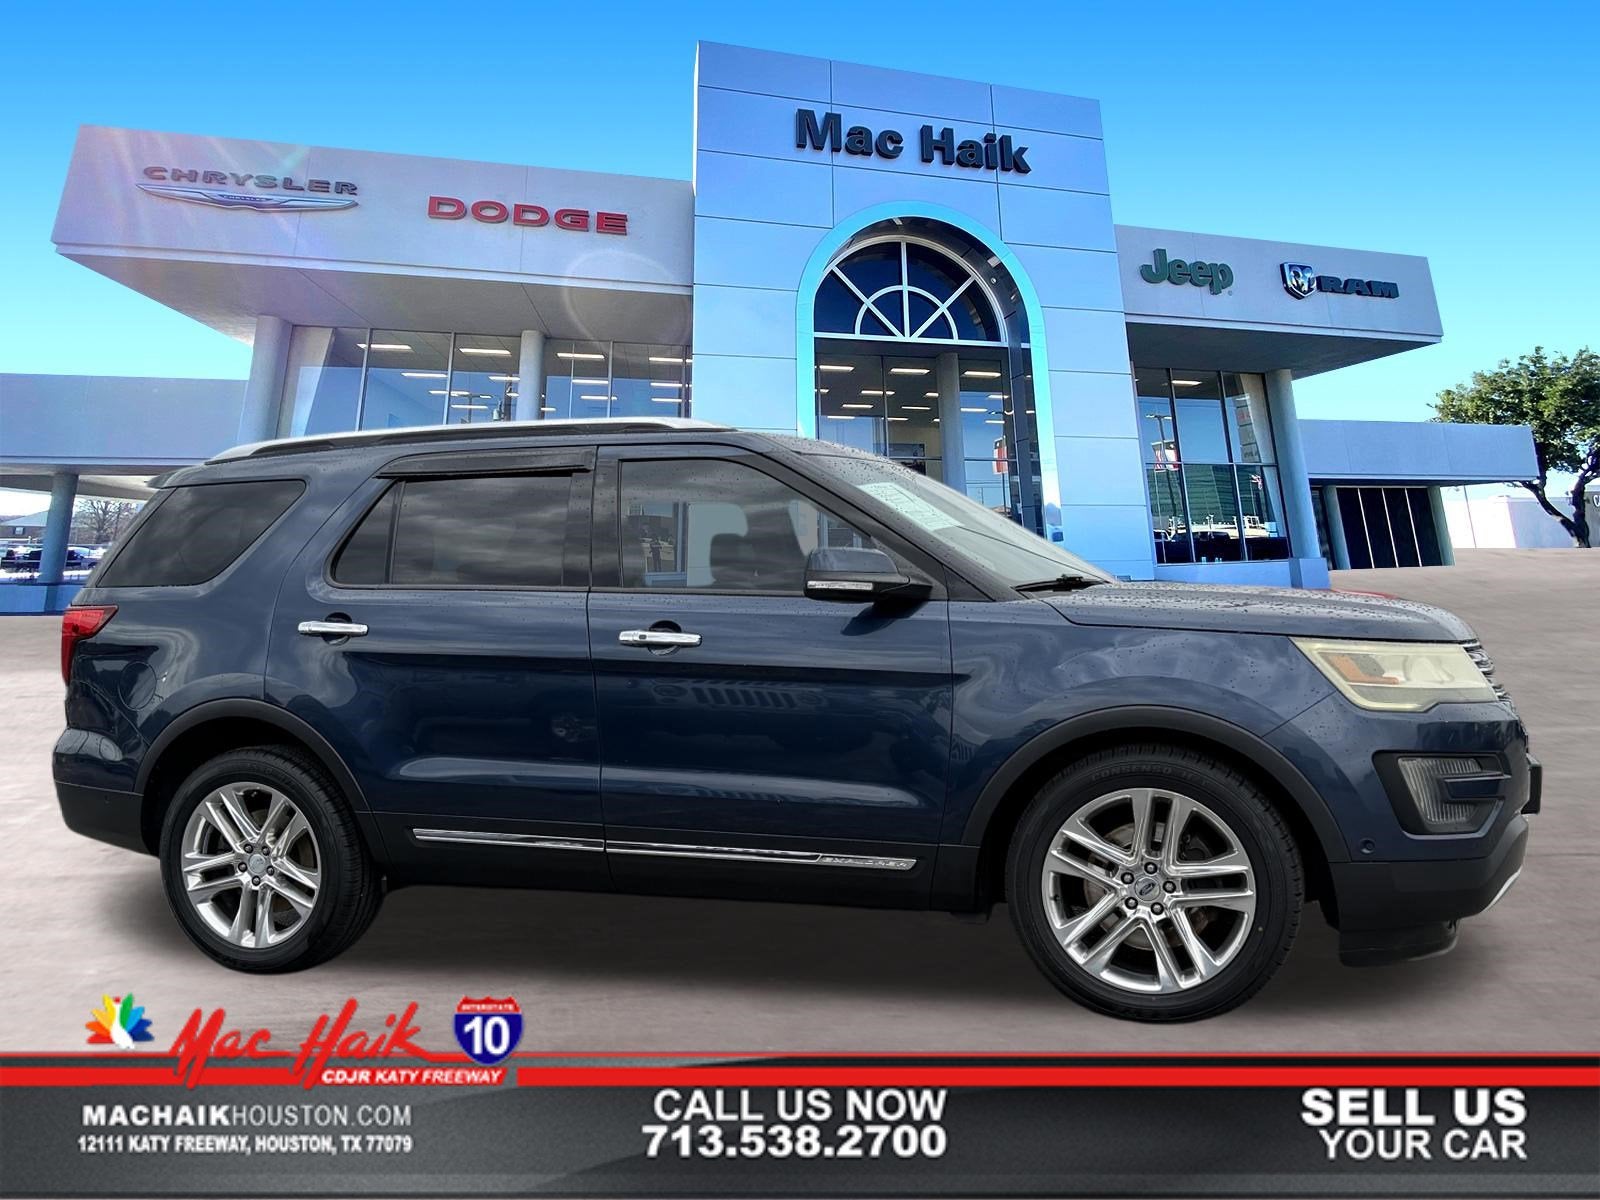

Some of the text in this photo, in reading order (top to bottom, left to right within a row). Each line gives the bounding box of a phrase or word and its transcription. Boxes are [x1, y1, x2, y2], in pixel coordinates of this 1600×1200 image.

[795, 108, 1032, 175] Mac Haik
[143, 166, 358, 195] CHRYSLER
[428, 196, 628, 236] DODGE
[1139, 248, 1234, 296] Jeep
[1316, 274, 1399, 299] RAM
